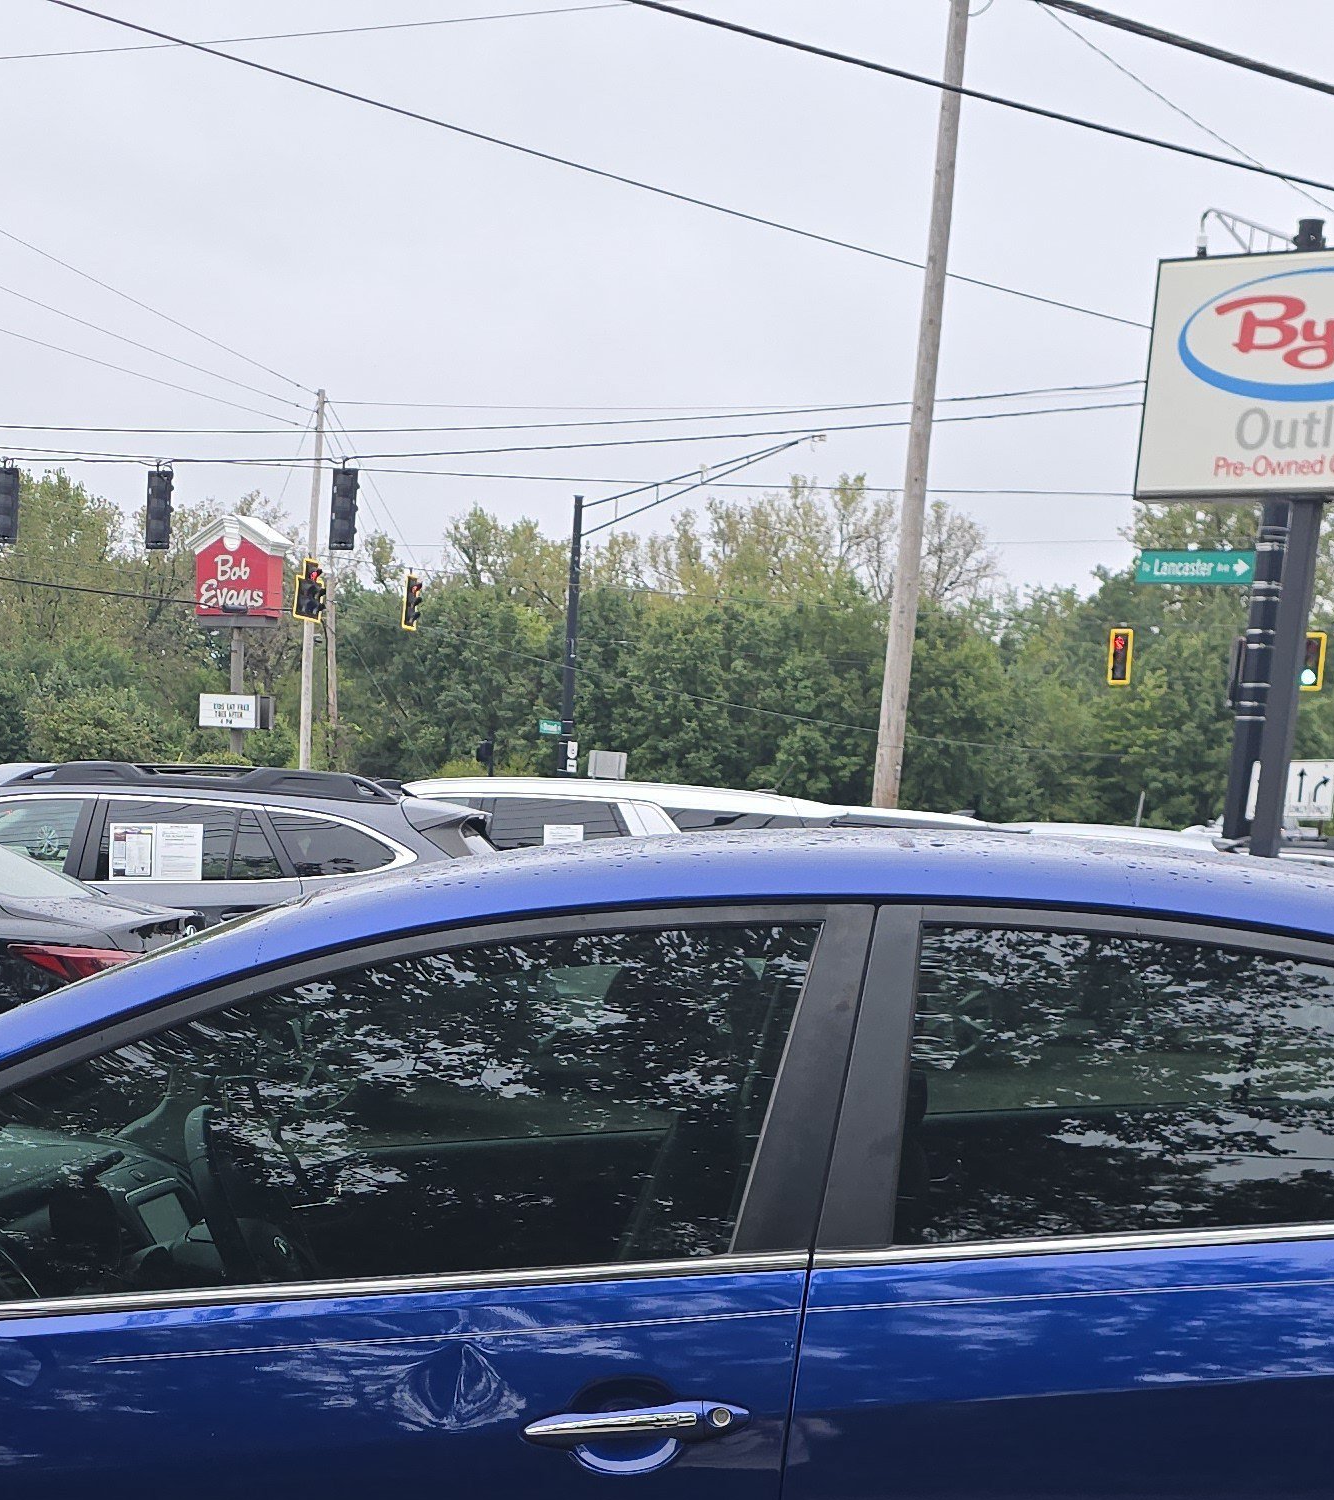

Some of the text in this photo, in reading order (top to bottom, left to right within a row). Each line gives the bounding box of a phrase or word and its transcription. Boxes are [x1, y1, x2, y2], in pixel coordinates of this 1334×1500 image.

[1212, 455, 1326, 477] Pre-Owned
[214, 554, 250, 581] Bob
[1153, 558, 1215, 577] Lancaster
[199, 578, 264, 609] Evans
